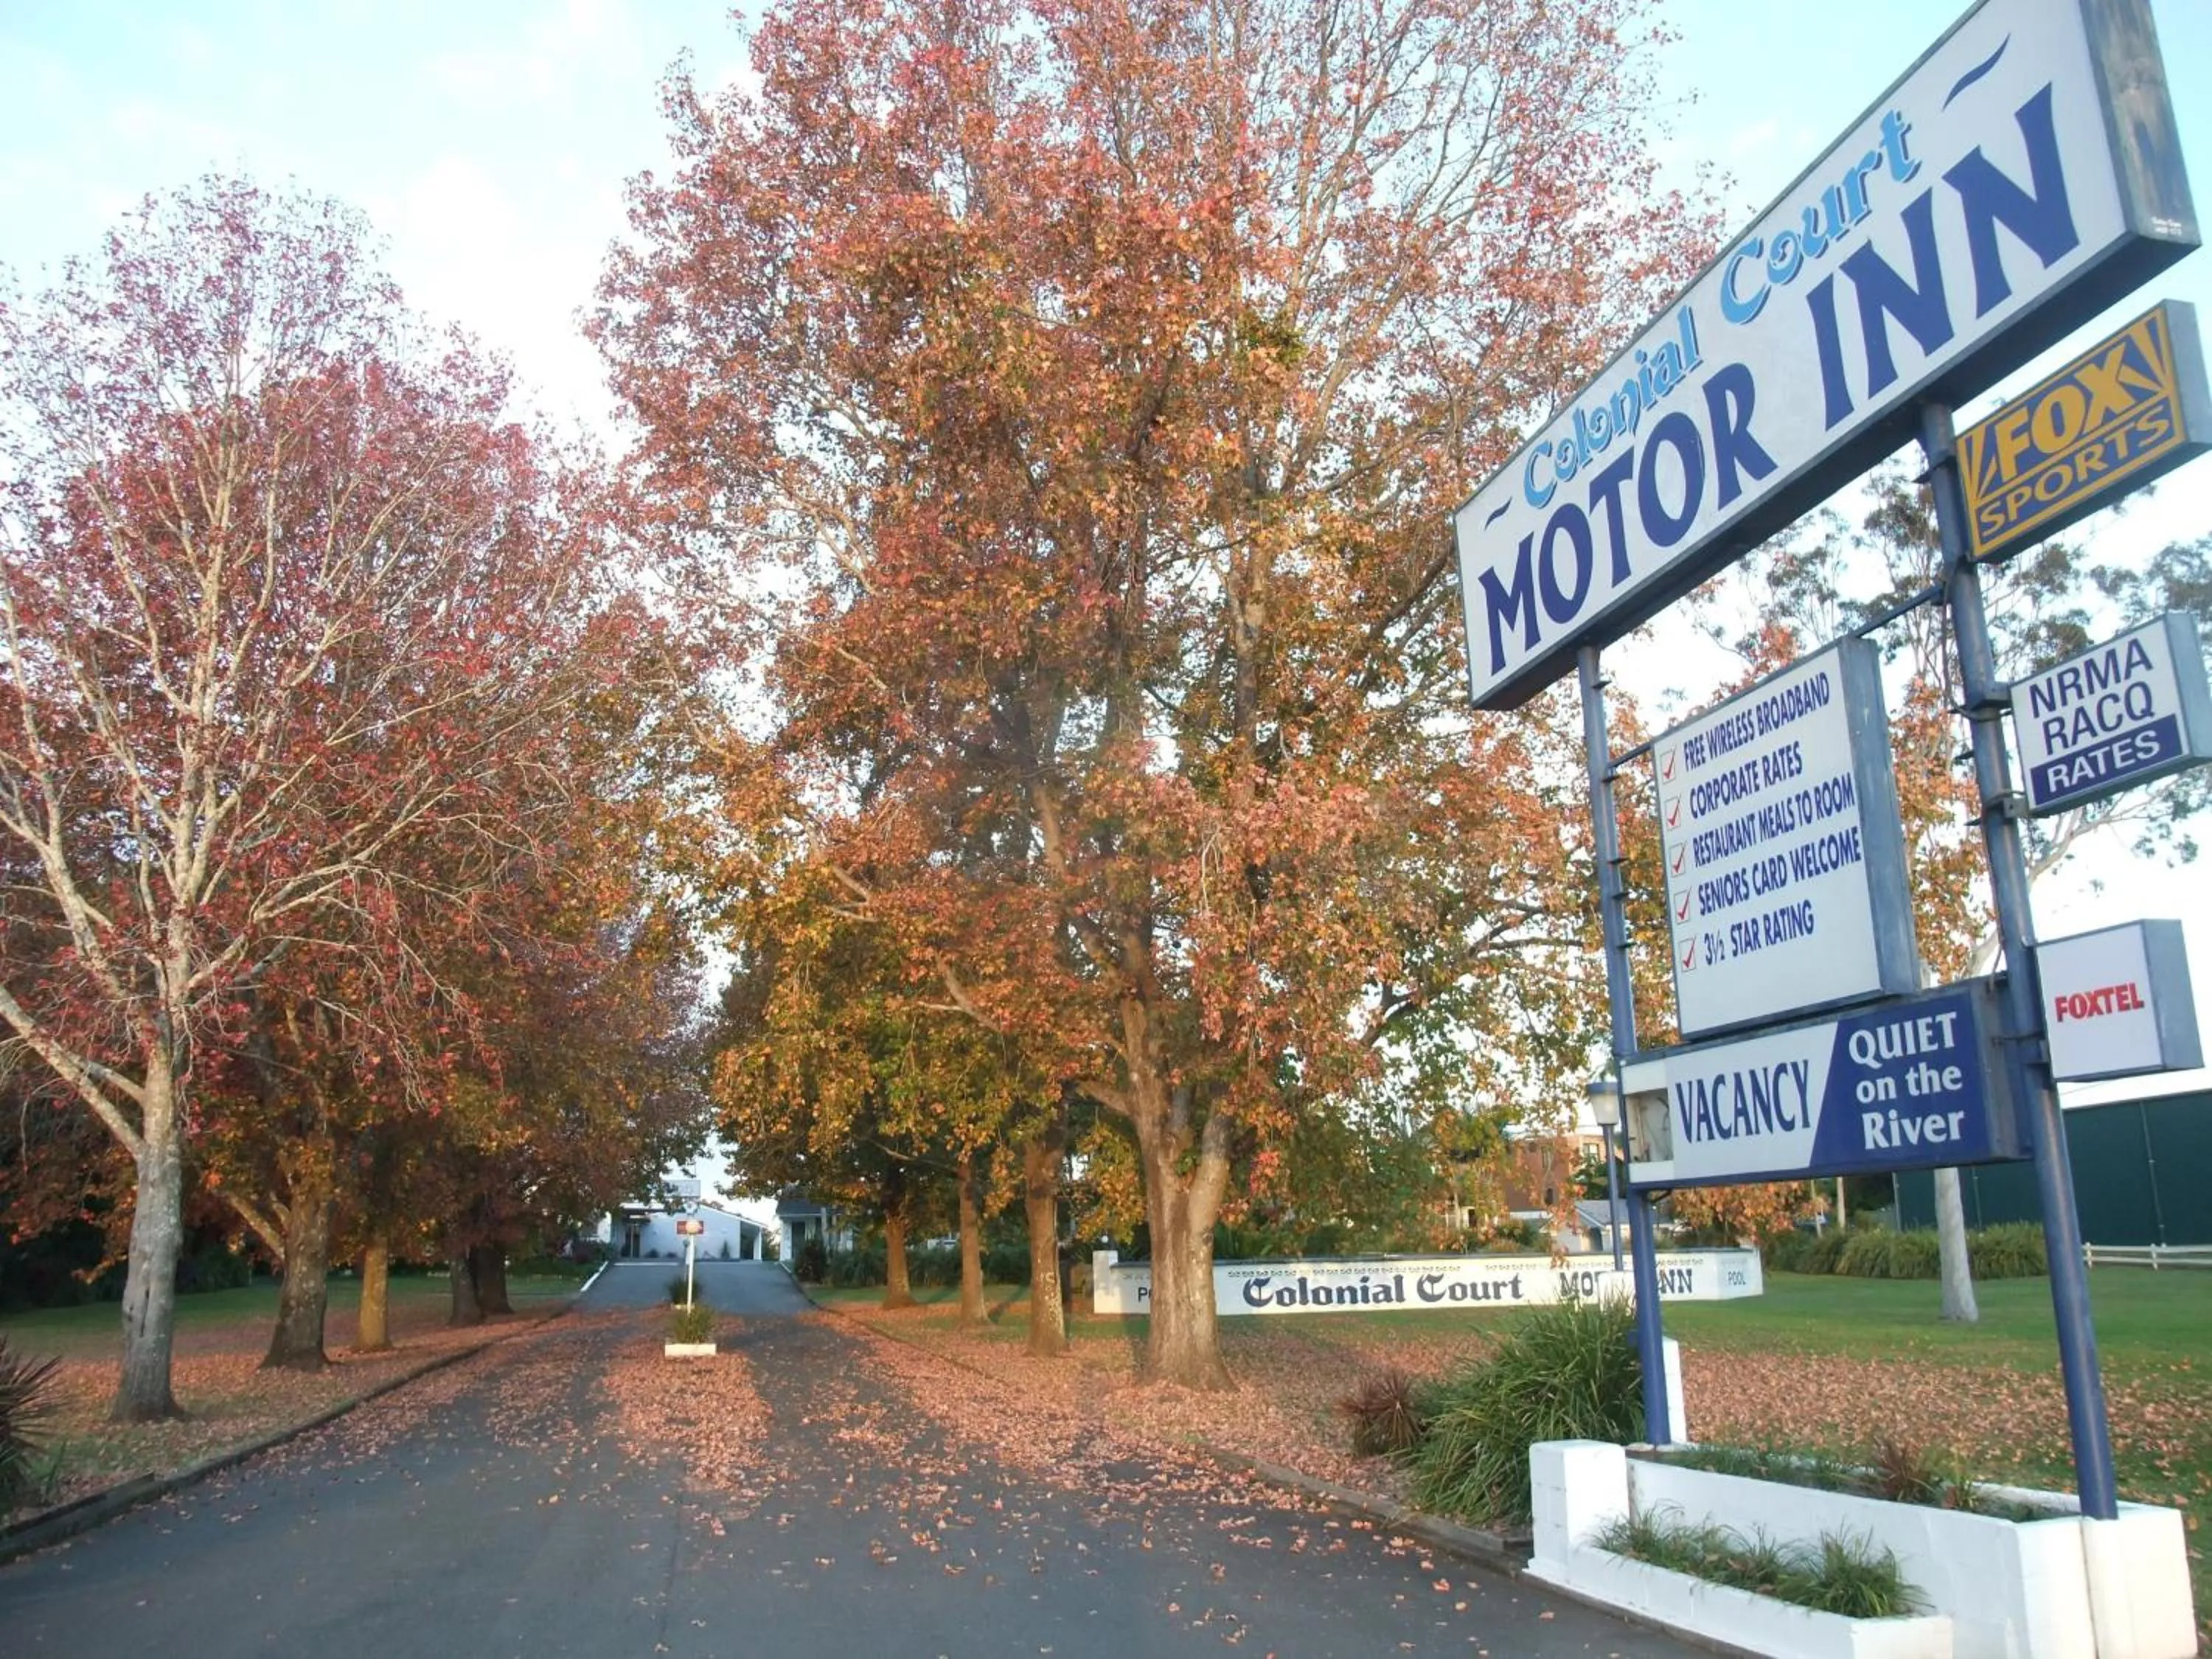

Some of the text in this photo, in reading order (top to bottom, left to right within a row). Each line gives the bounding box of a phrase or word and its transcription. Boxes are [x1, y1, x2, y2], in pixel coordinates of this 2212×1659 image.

[1523, 108, 1923, 509] Colonial Court
[1478, 81, 2079, 677] MOTOR INN
[1994, 341, 2136, 484] FOX
[1980, 405, 2171, 538] SPORTS
[2029, 637, 2154, 720] NRMA
[1683, 671, 1830, 772] FREE WIRELESS BROADBAND
[2042, 681, 2156, 757] RACQ
[1689, 740, 1803, 819] CORPORATE RATES
[2047, 729, 2160, 793] RATES
[1693, 772, 1855, 867] RESTAURANT MEALS TO ROOM
[1698, 827, 1862, 917] SENIORS CARD WELCOME
[1731, 919, 1761, 957] STAR
[1763, 899, 1815, 947] RATING
[1848, 1012, 1958, 1069] QUIET
[2055, 982, 2146, 1023] FOXTEL
[1675, 1060, 1812, 1144] VACANCY
[1856, 1062, 1964, 1104] on the
[1862, 1110, 1965, 1150] River
[1242, 1273, 1405, 1307] Colonial
[1416, 1273, 1523, 1303] Court
[1659, 1268, 1693, 1294] NN
[1728, 1271, 1747, 1285] POOL
